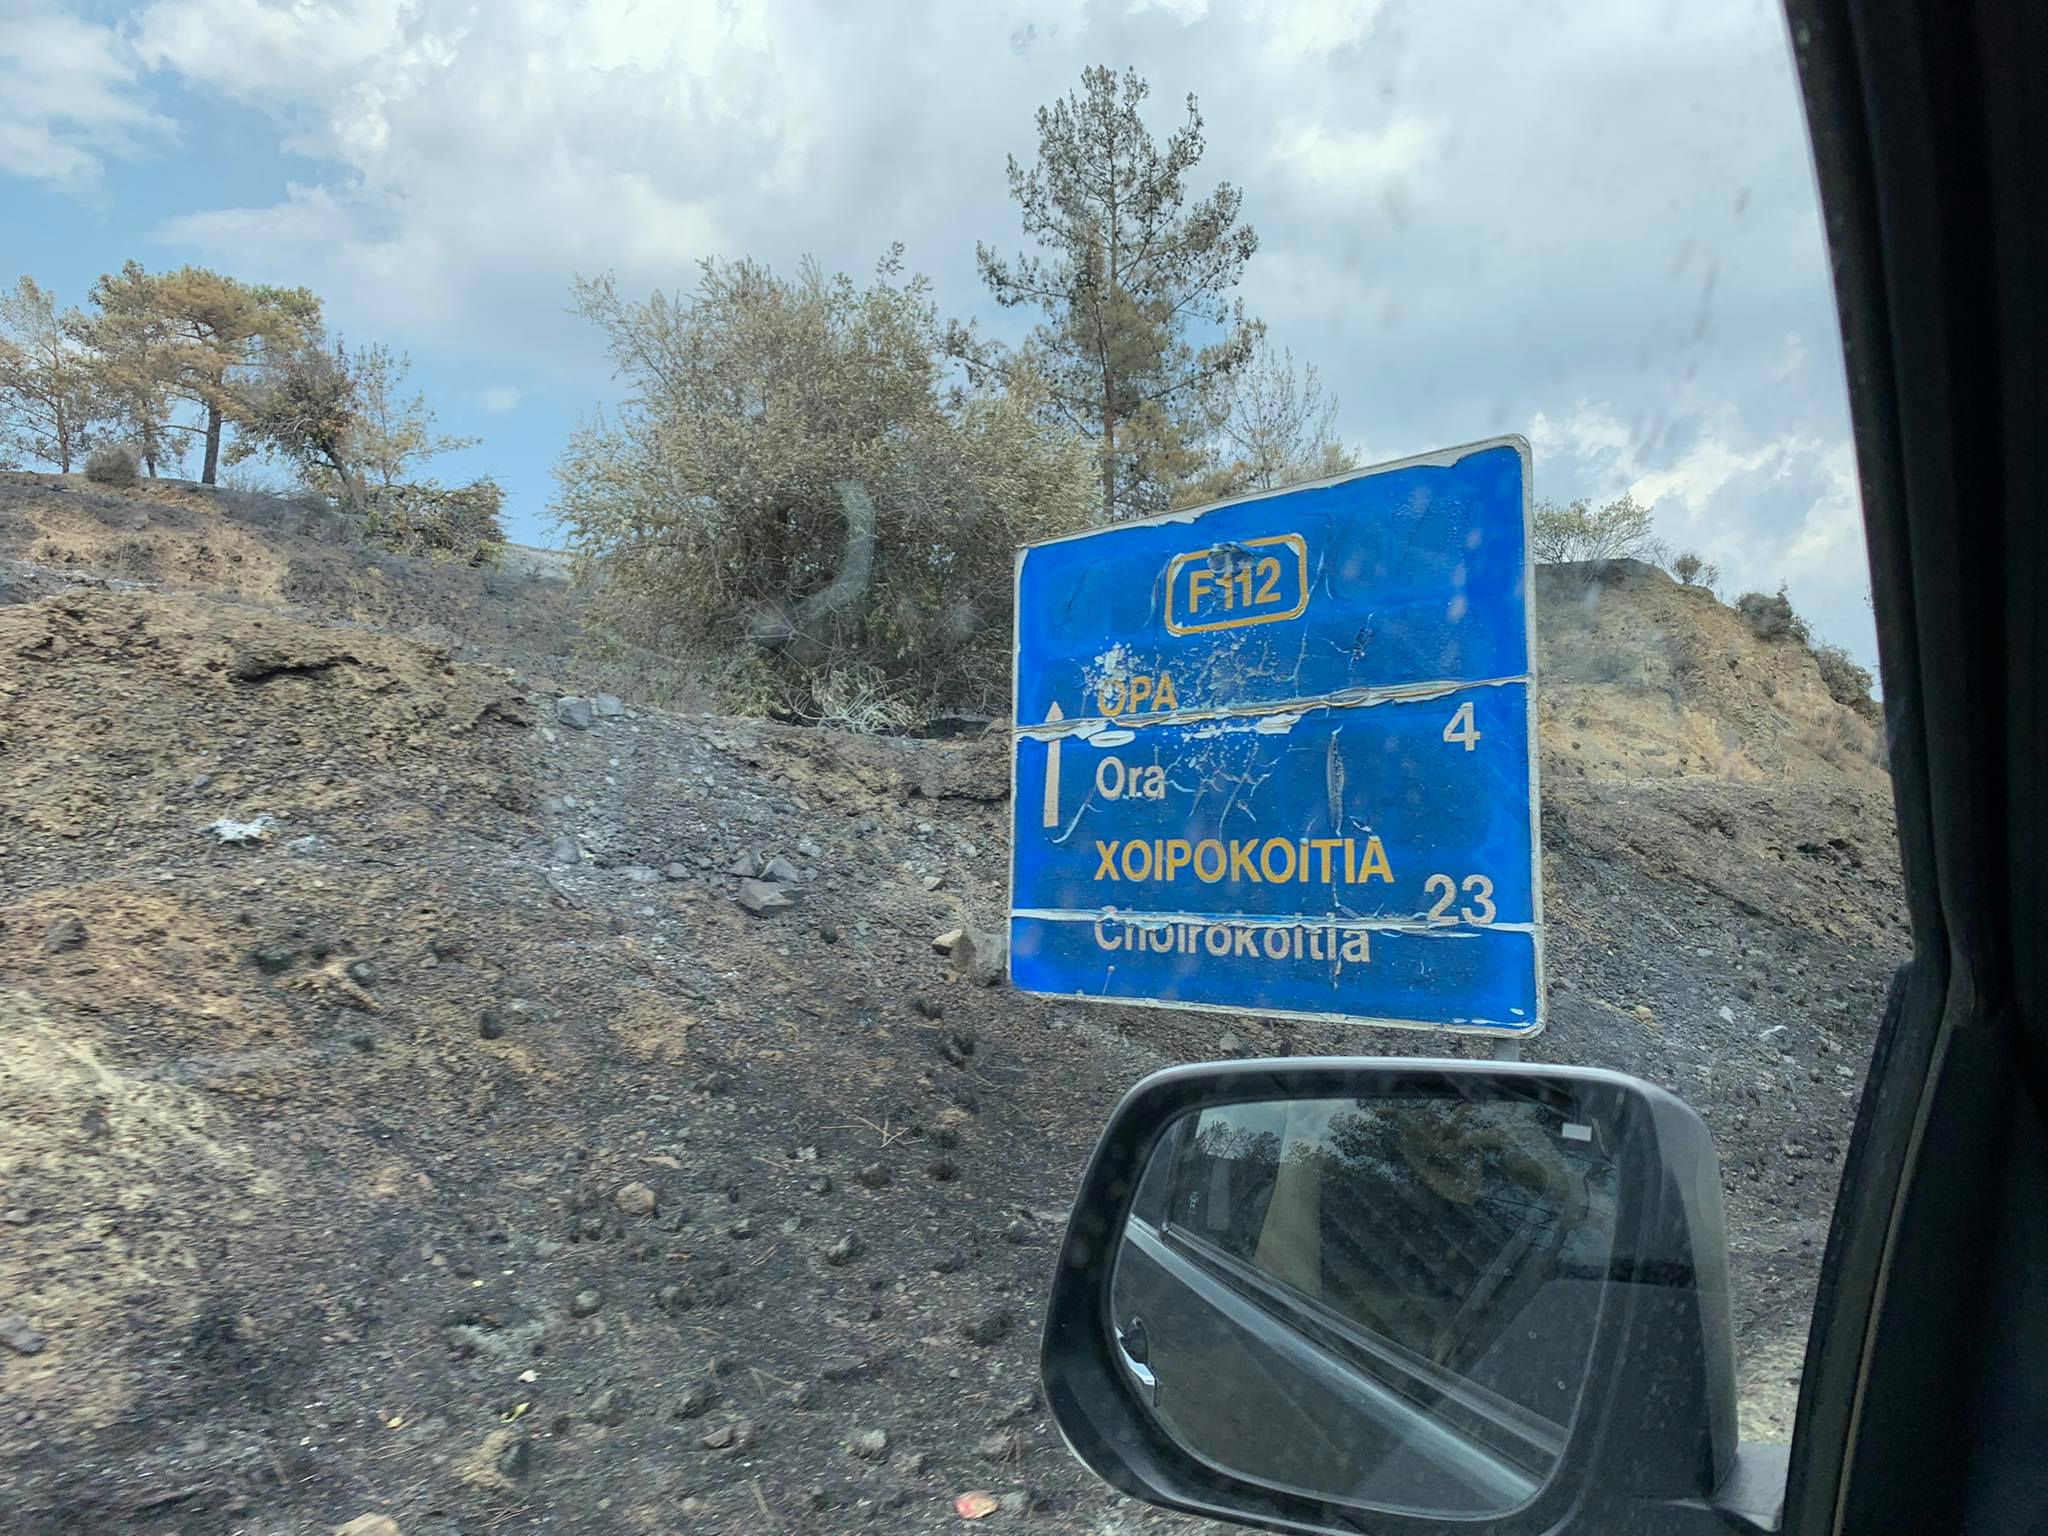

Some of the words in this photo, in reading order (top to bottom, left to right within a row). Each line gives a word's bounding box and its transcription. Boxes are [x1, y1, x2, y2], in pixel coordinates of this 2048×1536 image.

[1189, 556, 1281, 614] F112
[1443, 701, 1481, 751] 4
[1096, 756, 1165, 801] Ora
[1424, 873, 1497, 925] 23
